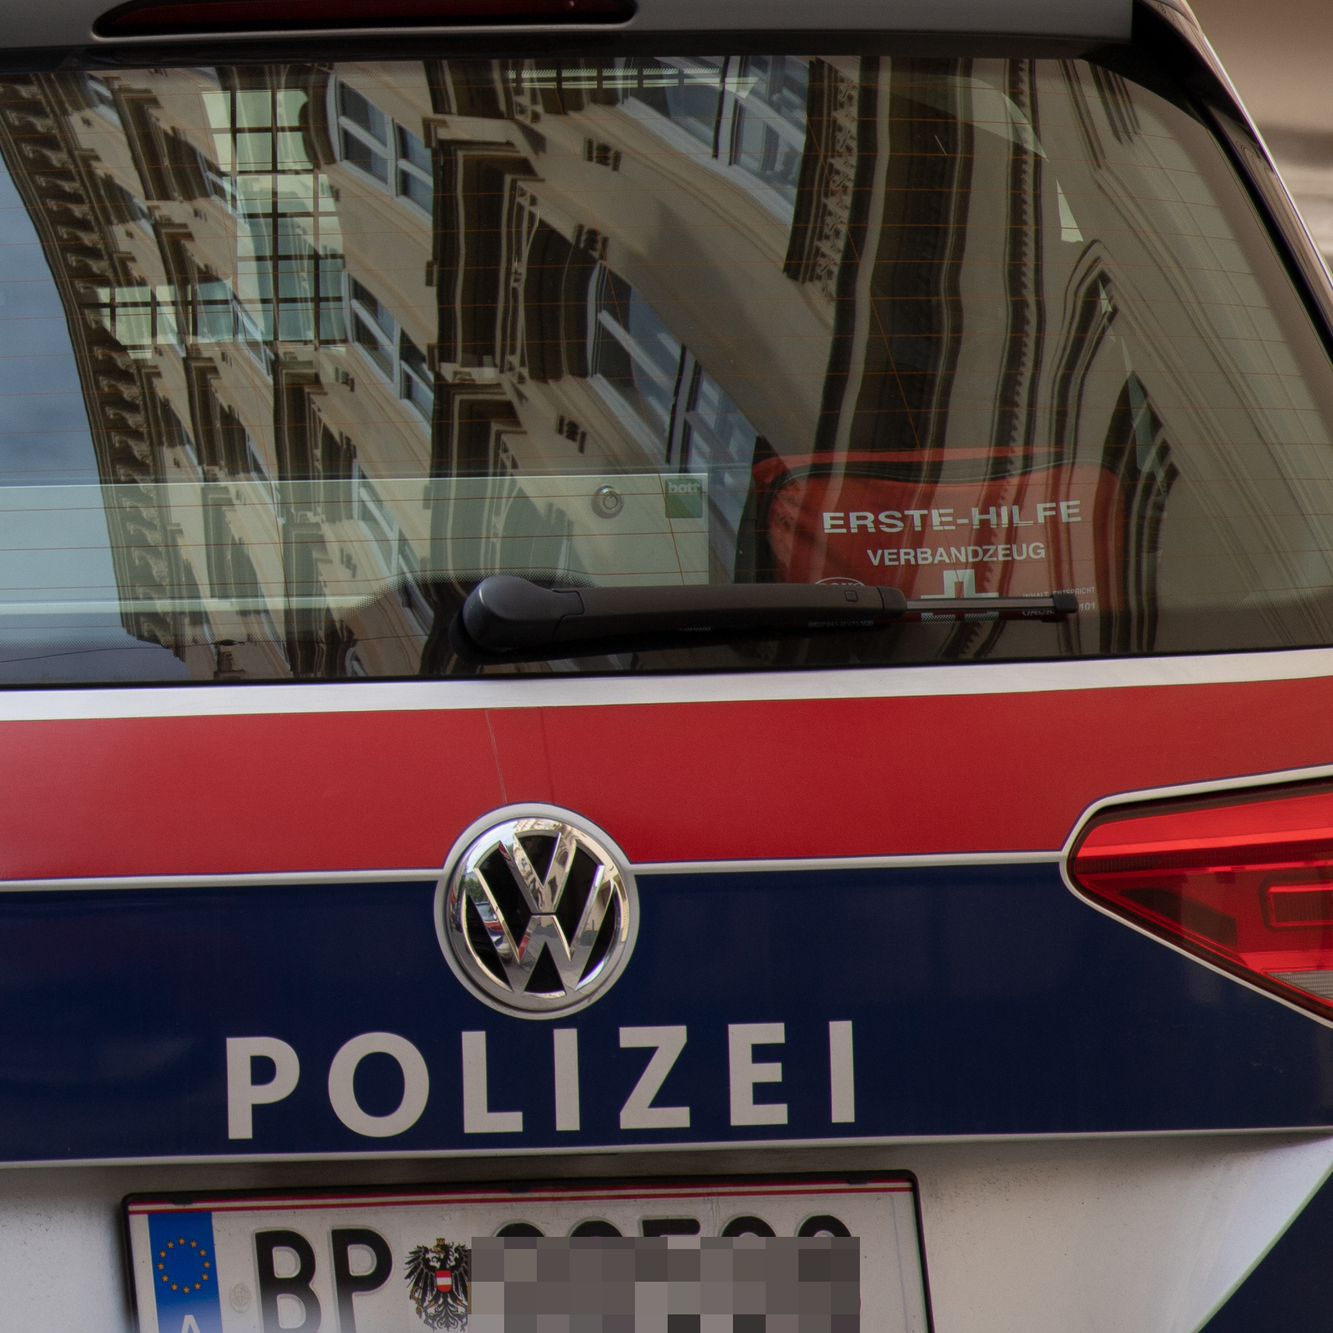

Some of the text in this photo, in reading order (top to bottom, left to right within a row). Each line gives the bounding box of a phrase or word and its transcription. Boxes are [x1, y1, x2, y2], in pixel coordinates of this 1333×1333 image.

[822, 500, 1082, 534] ERSTE-HILFE
[866, 542, 1046, 566] VERBANDZEUG
[225, 1019, 856, 1140] POLIZEI
[254, 1228, 394, 1333] BP
